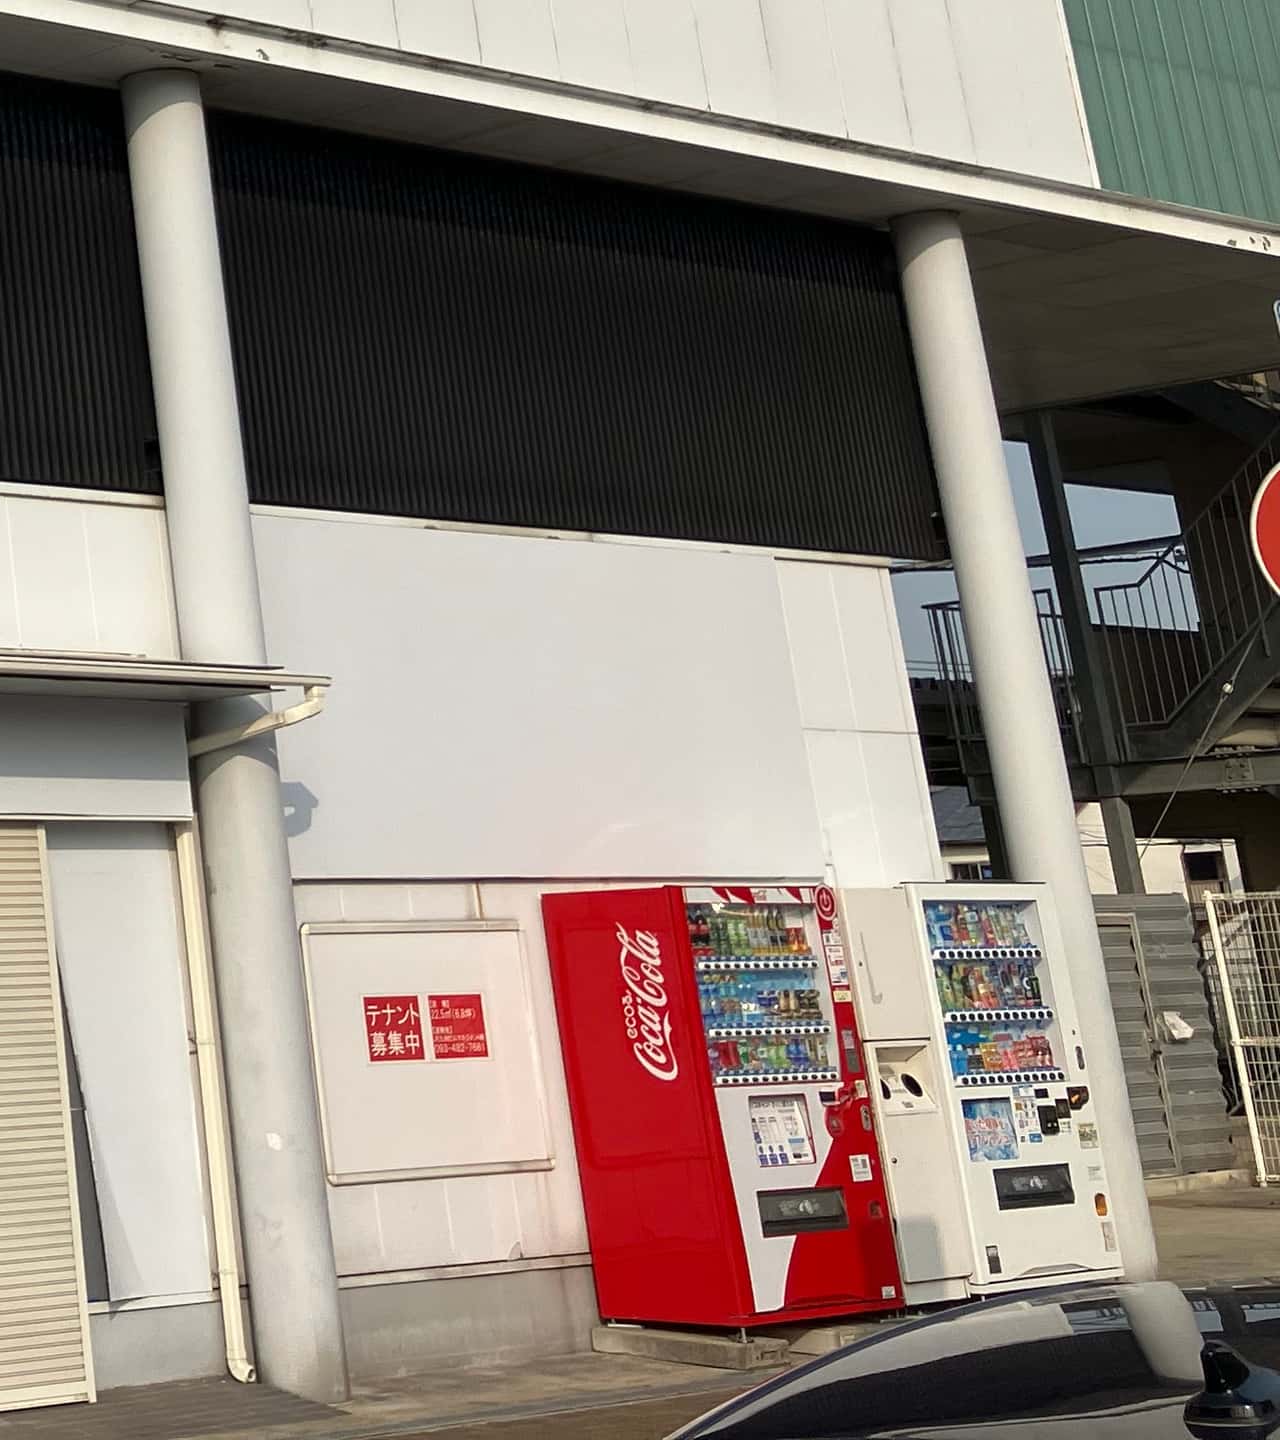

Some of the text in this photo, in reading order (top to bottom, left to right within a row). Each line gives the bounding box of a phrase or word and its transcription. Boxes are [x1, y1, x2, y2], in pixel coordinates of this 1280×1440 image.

[367, 1003, 420, 1026] テナント
[370, 1030, 420, 1056] 募集中
